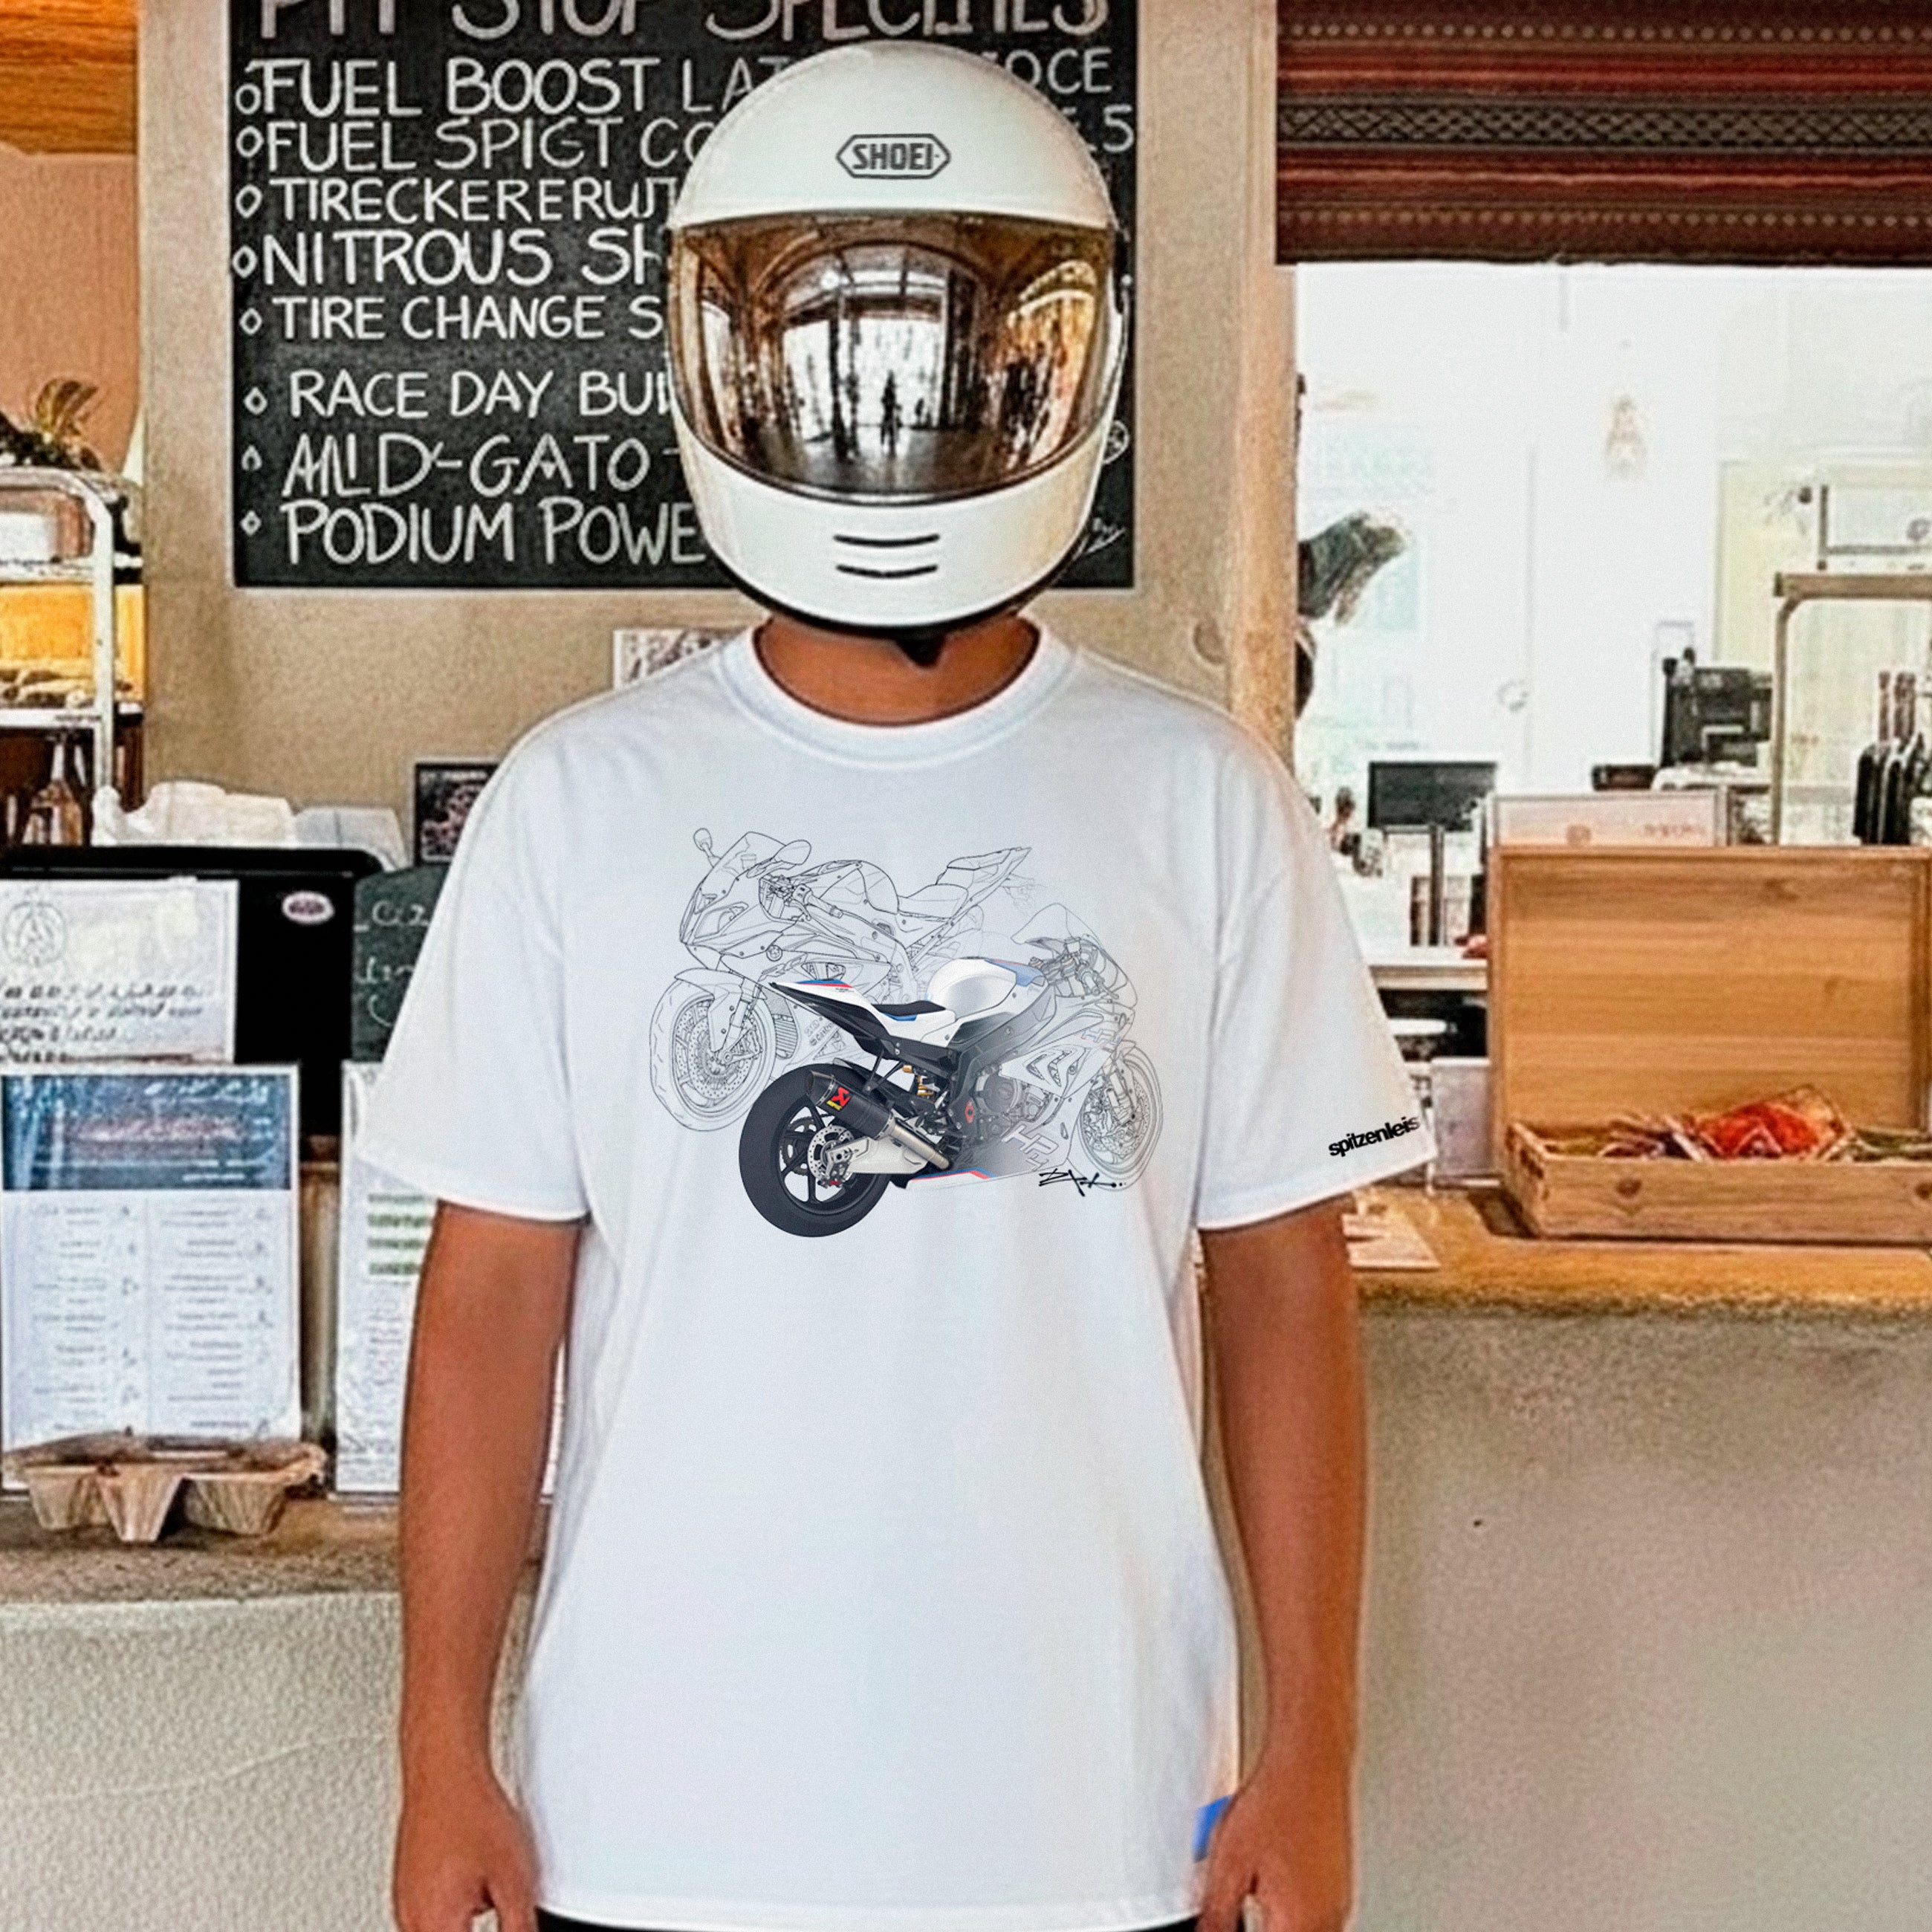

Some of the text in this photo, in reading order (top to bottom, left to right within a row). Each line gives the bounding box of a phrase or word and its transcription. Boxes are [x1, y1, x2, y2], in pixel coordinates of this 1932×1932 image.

[244, 59, 423, 117] FUEL
[446, 56, 661, 116] BOOST
[267, 120, 418, 173] FUEL
[852, 143, 934, 171] SHOEI
[262, 227, 554, 288] NITROUS
[270, 295, 386, 340] TIRE
[401, 294, 608, 341] CHANGE
[288, 368, 430, 420] RACE
[449, 368, 556, 420] DAY
[278, 495, 707, 565] PODIUM POWE
